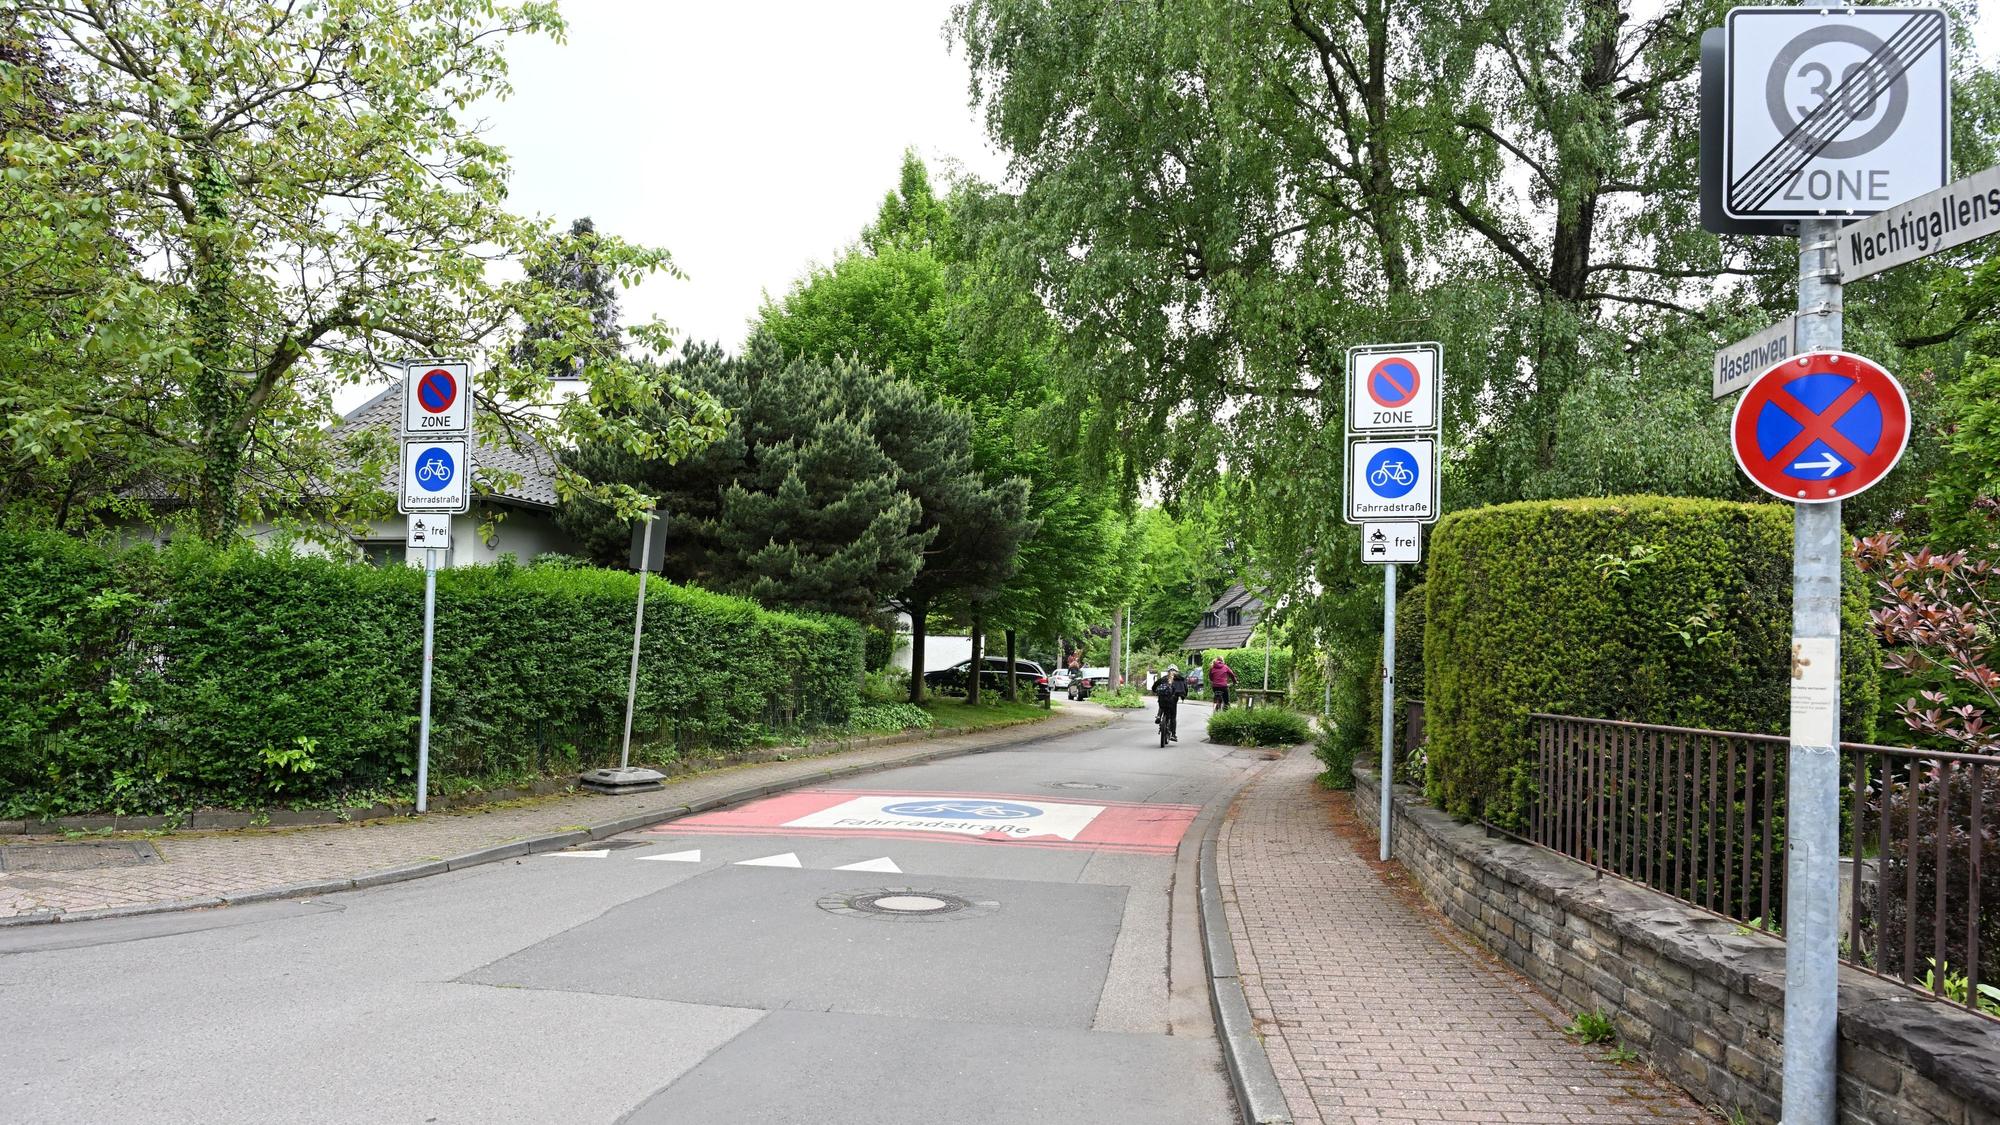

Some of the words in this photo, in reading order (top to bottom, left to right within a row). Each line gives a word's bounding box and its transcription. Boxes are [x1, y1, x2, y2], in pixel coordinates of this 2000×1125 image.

[1796, 62, 1877, 121] 30
[1783, 170, 1890, 201] ZONE
[1719, 335, 1787, 385] Hasenweg
[421, 416, 451, 428] ZONE
[1373, 411, 1413, 424] ZONE
[407, 495, 460, 504] Fahrradstraße
[1356, 502, 1427, 512] Fahrradstraße
[431, 526, 447, 535] frei
[1395, 536, 1416, 547] frei
[833, 818, 1030, 834] Fahrradstraße
